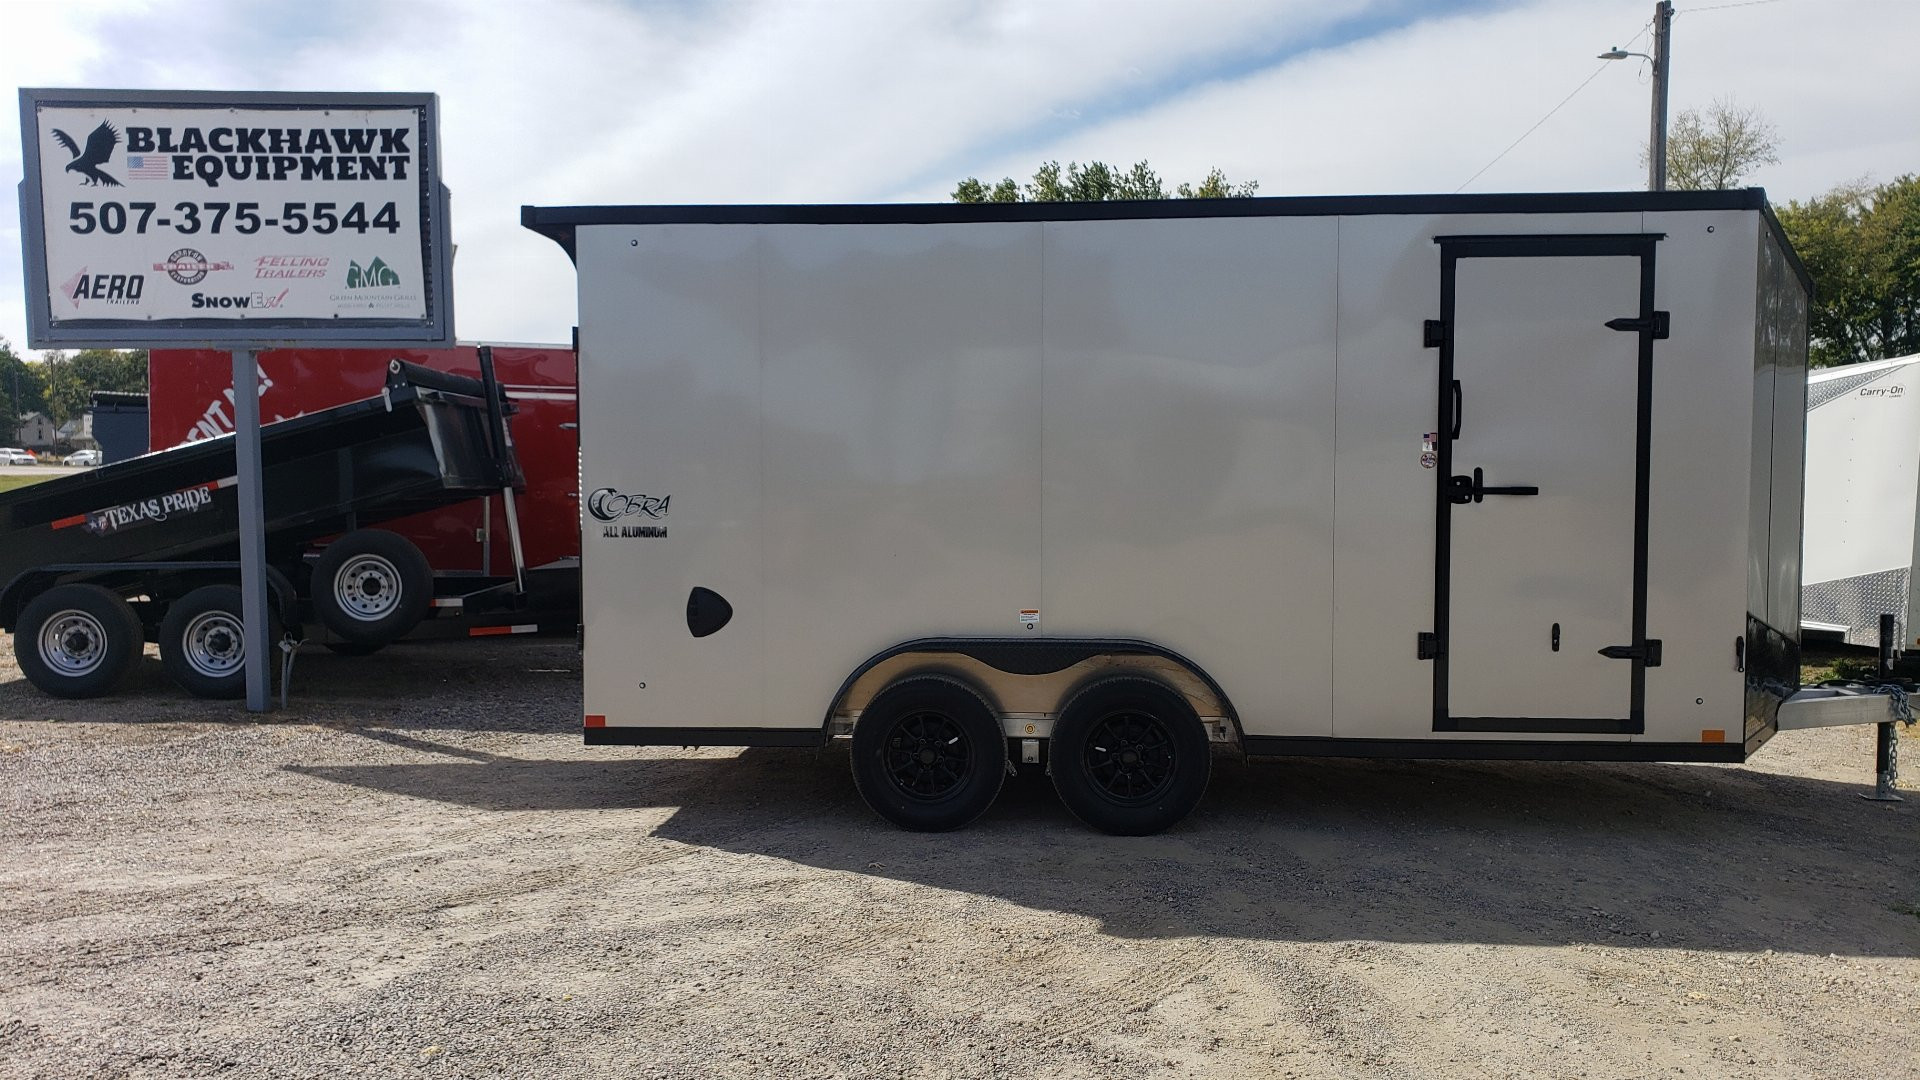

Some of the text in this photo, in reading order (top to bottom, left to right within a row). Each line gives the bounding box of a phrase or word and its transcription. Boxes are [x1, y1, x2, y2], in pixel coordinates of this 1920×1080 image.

[125, 127, 411, 154] BLACKHAWK
[171, 155, 411, 188] EQUIPMENT
[69, 201, 401, 235] 507-375-5544
[254, 256, 330, 267] FELLING
[255, 267, 328, 279] TRAILERS
[72, 274, 145, 300] AERO
[346, 264, 397, 290] GMG
[1860, 386, 1904, 398] Carry-On
[105, 499, 168, 531] TEXAS
[162, 486, 212, 513] PRIDE
[603, 526, 668, 539] ALL ALUMINUM
